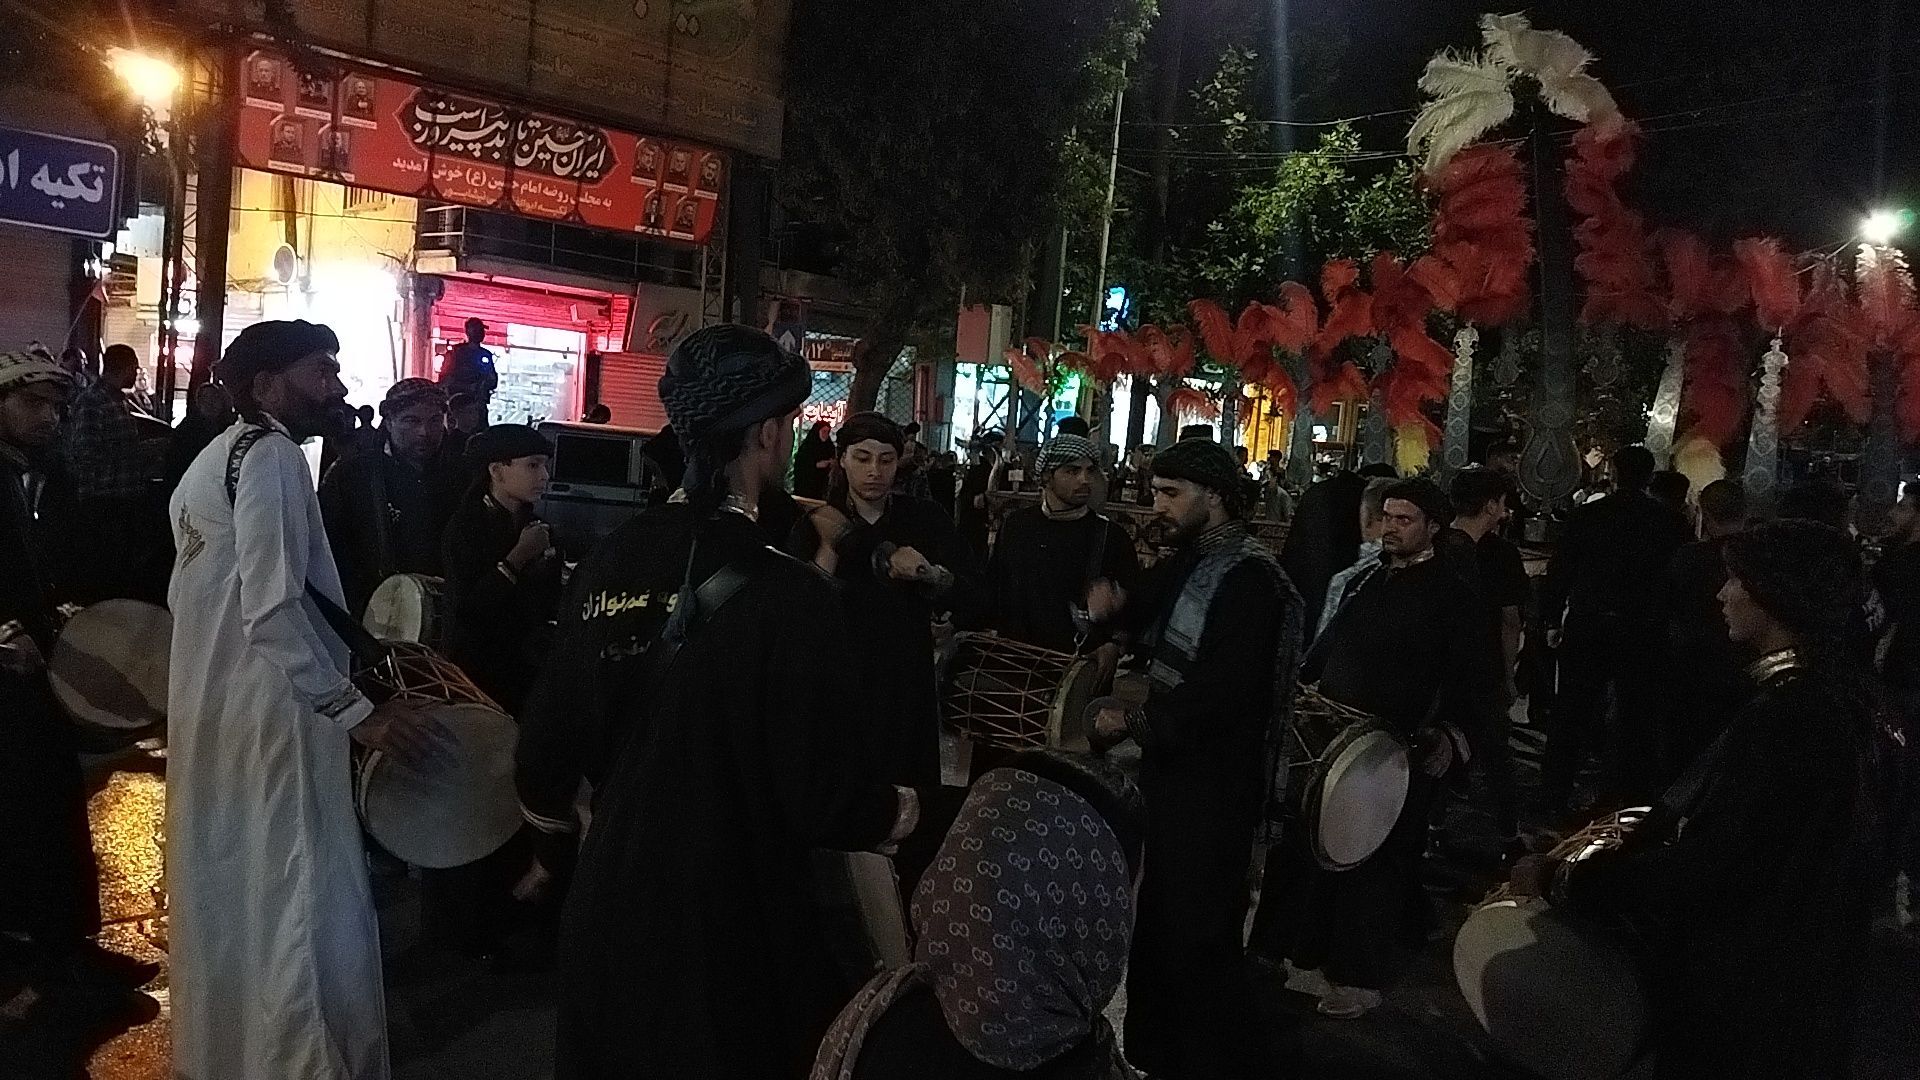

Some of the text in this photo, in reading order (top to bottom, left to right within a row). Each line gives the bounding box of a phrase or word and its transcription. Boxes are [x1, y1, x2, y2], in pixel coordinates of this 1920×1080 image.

[414, 101, 488, 129] است
[412, 119, 510, 158] پیروز
[517, 119, 542, 141] تا
[514, 127, 592, 168] حسین
[553, 136, 607, 178] ایران
[392, 157, 429, 172] آمدید
[432, 163, 463, 182] خوش
[0, 149, 106, 210] تکیه ا
[465, 167, 487, 187] (ع)
[487, 177, 520, 191] حین
[520, 180, 542, 195] امام
[543, 185, 569, 204] روضه
[602, 197, 613, 210] به
[231, 431, 257, 493] YAMAHA
